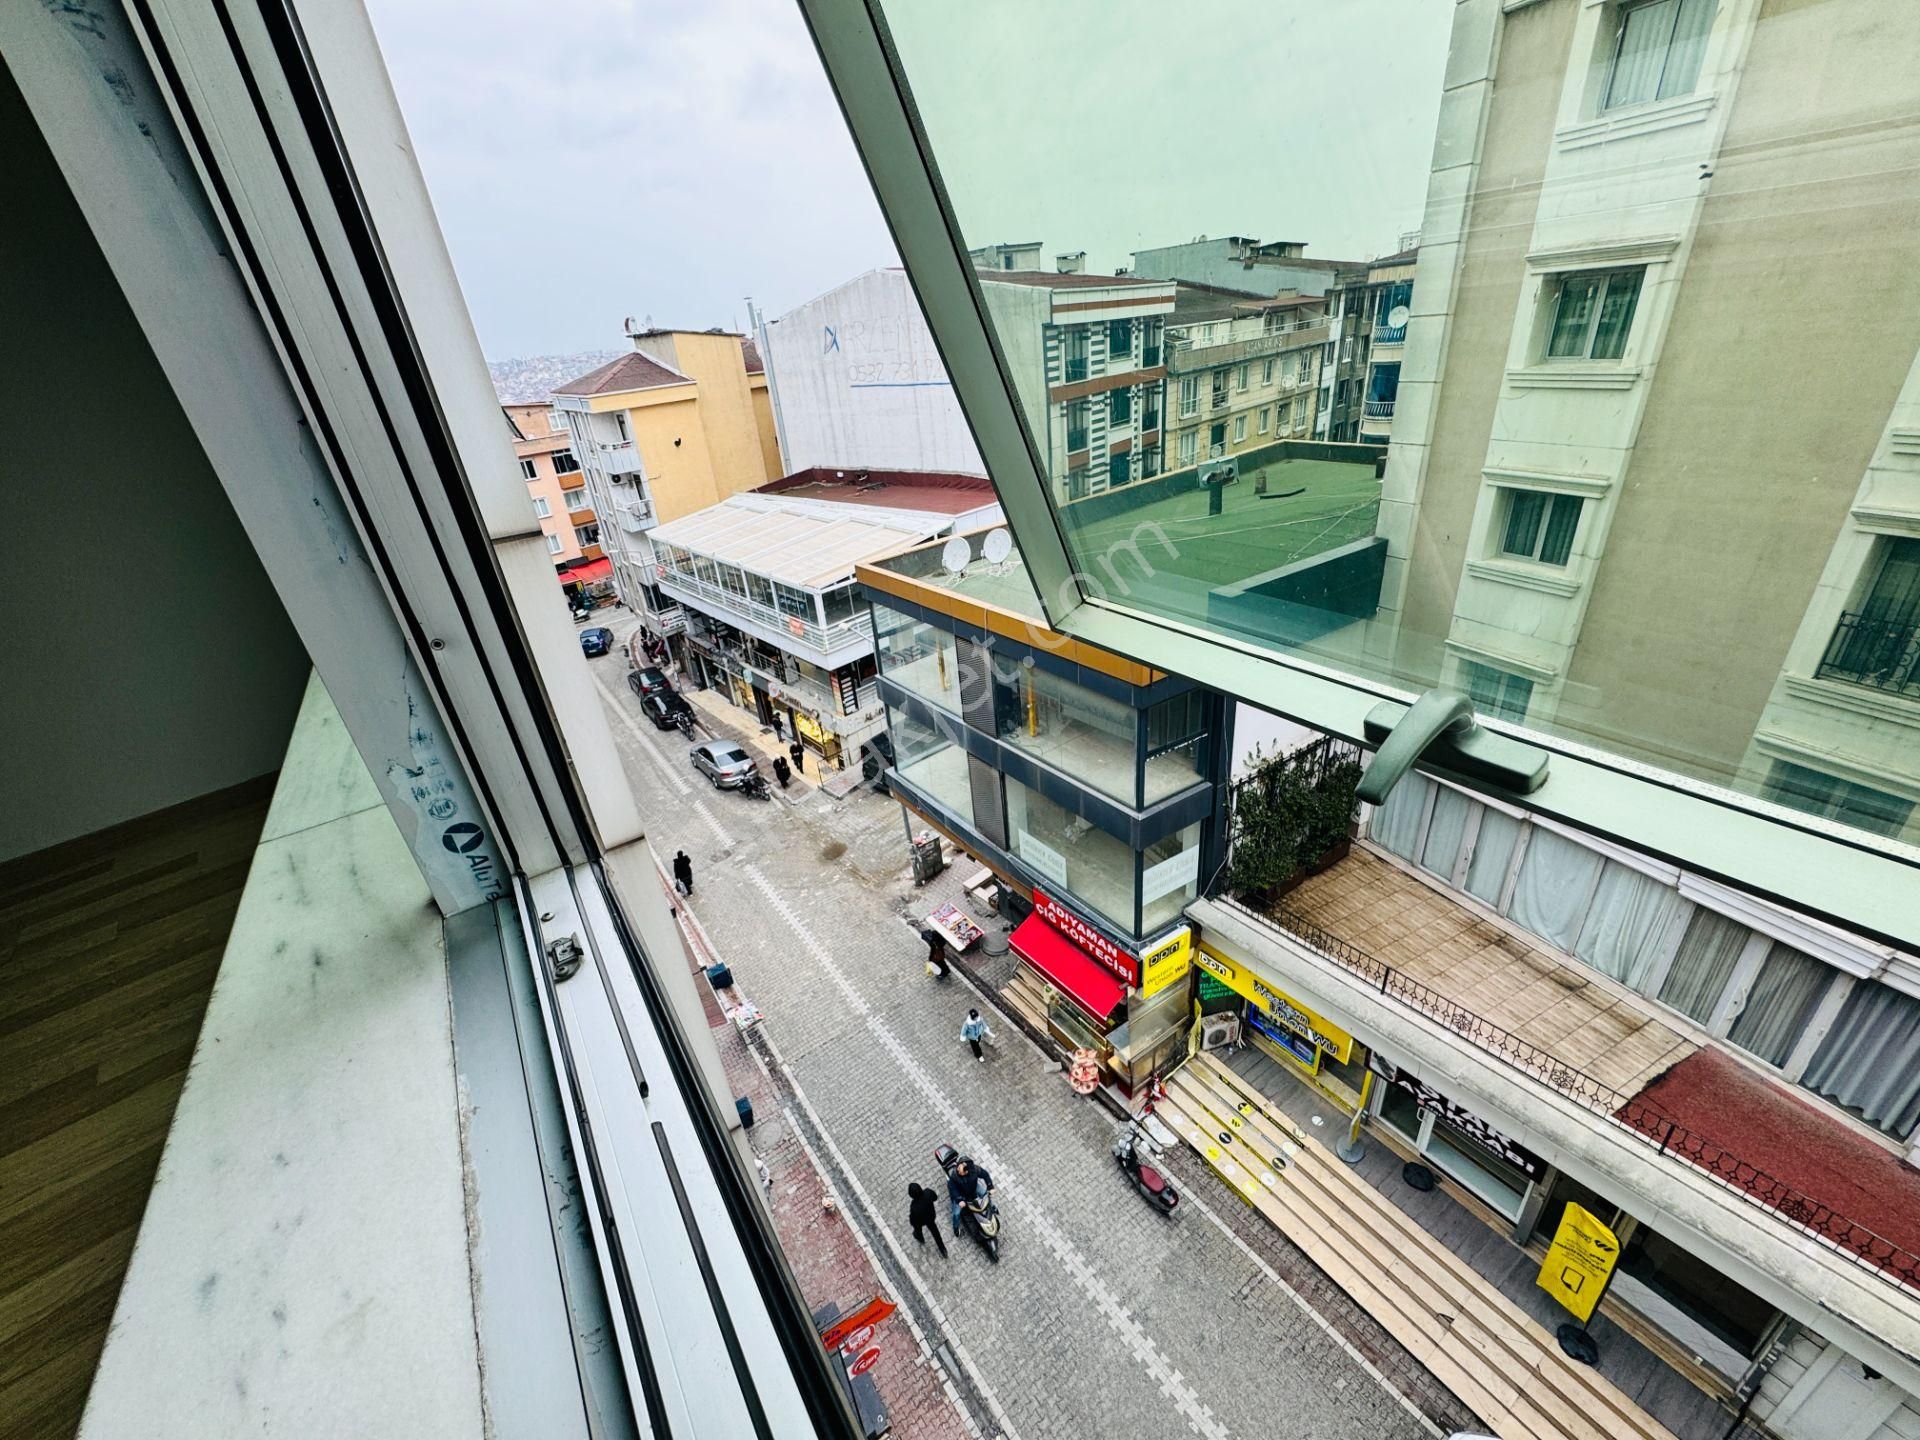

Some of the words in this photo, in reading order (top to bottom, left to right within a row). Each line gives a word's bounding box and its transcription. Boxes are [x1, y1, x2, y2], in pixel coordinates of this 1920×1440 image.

[1047, 902, 1118, 958] ADIYAMAN
[1253, 979, 1309, 1026] Western
[1398, 1080, 1535, 1174] AYAKKABI
